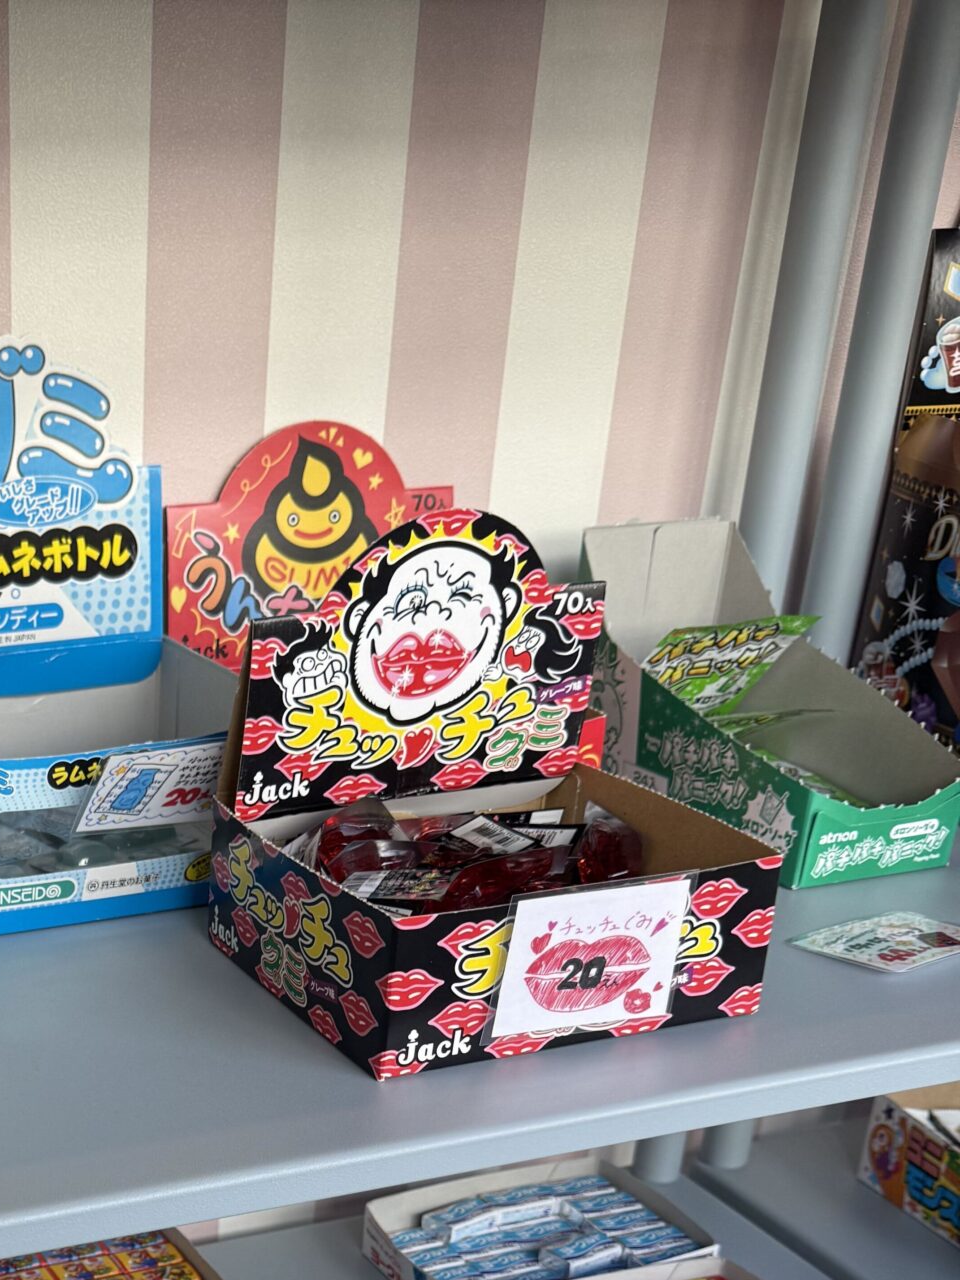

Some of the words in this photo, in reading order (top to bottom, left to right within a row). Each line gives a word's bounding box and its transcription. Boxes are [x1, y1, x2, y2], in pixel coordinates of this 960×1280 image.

[539, 681, 584, 702] グレープ味
